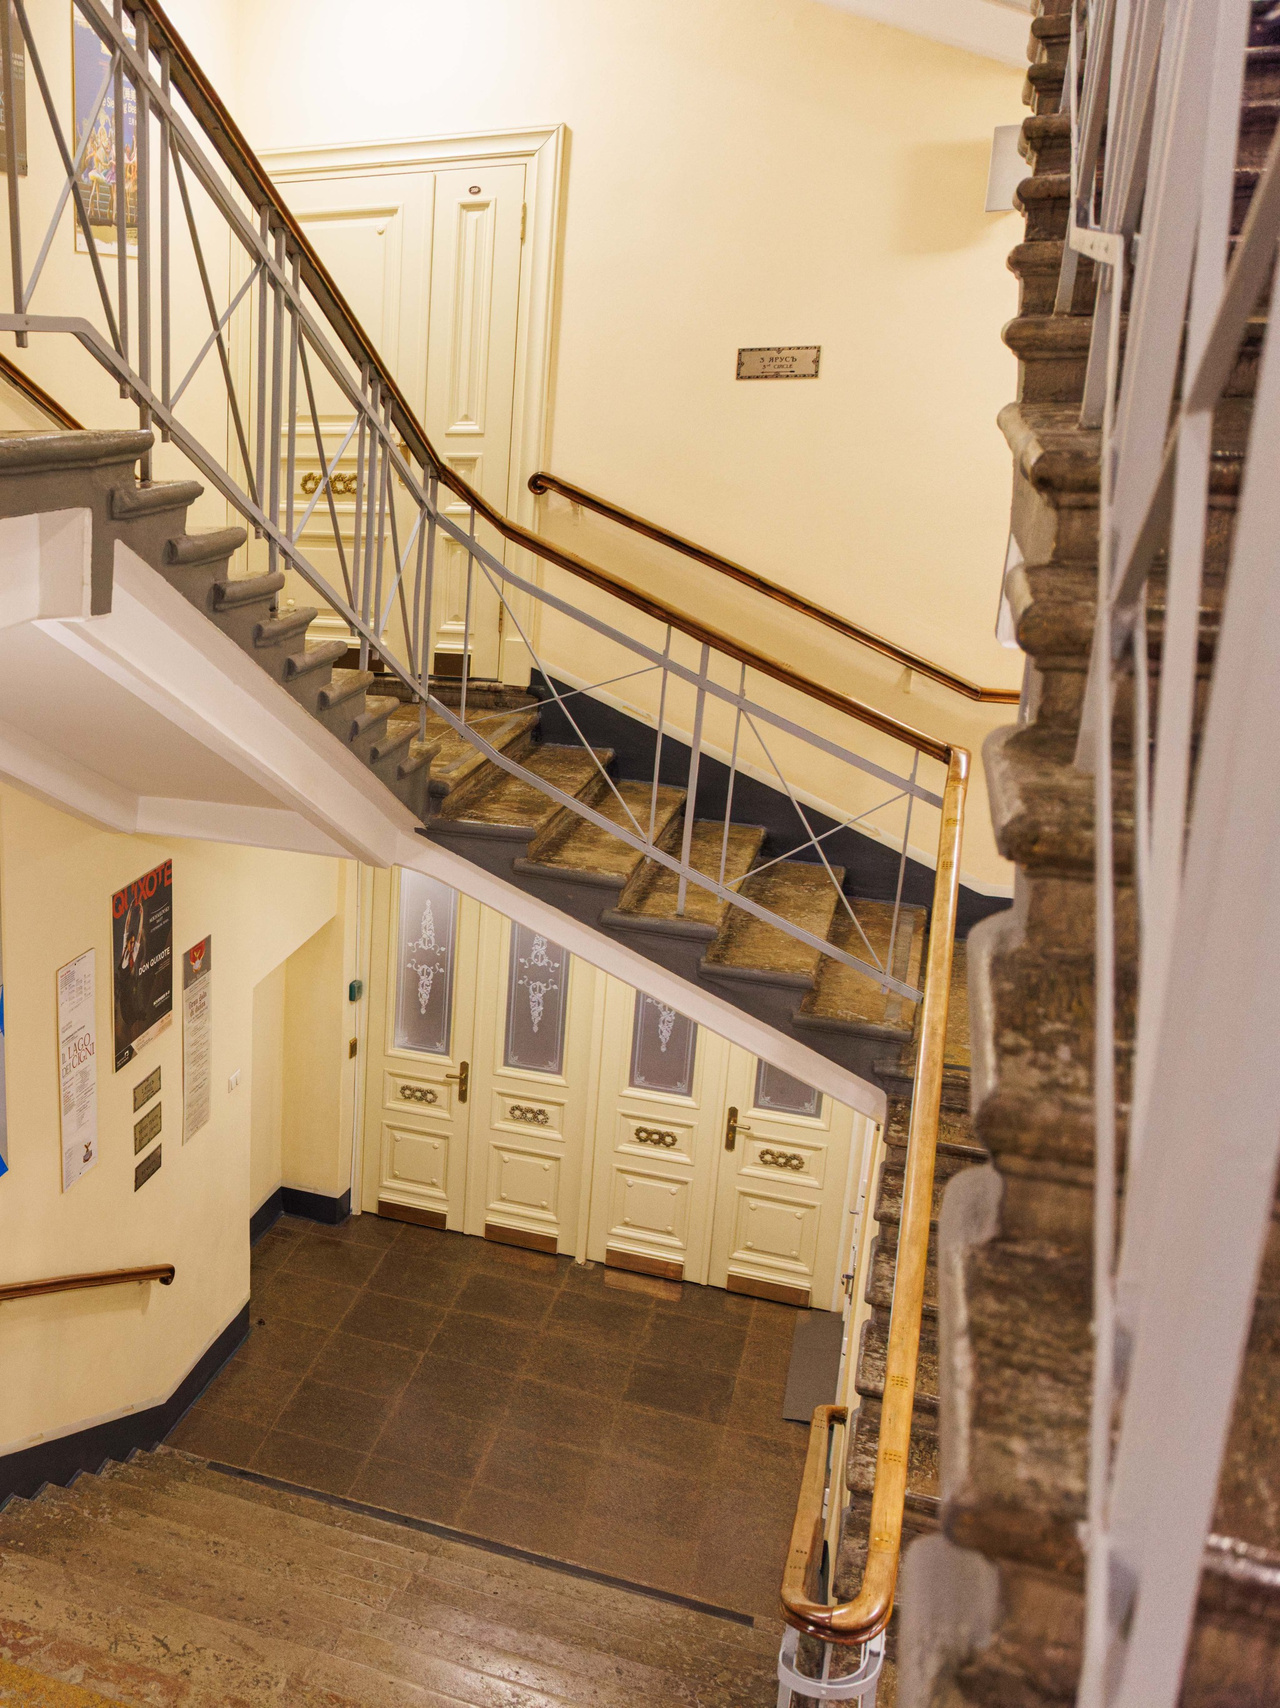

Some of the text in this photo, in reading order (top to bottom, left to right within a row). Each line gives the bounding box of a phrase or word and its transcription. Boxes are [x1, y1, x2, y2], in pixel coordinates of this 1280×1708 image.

[139, 947, 169, 975] DON QUIXOTE
[68, 1033, 91, 1059] LAGO
[72, 1042, 95, 1068] CIGNI
